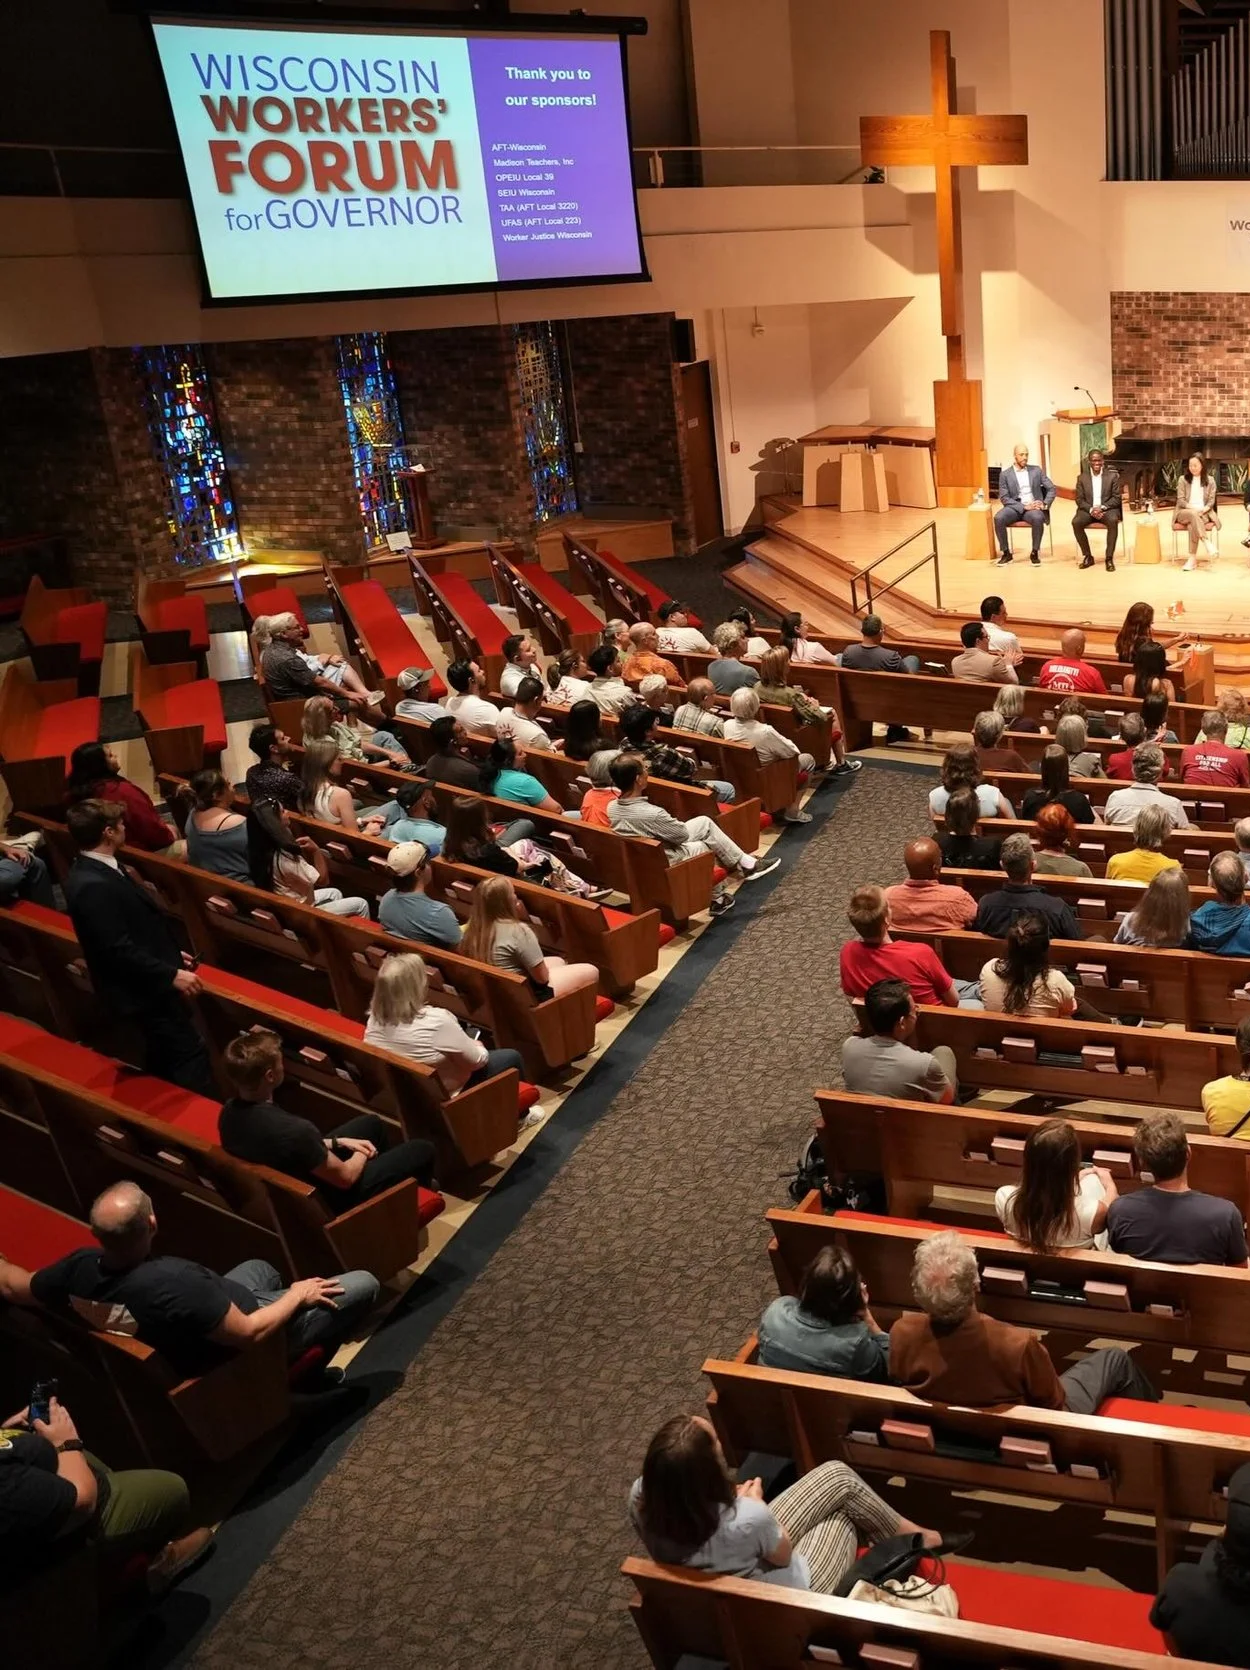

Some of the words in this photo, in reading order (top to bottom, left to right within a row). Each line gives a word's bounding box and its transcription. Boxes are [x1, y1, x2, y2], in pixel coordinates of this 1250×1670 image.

[191, 53, 439, 93] WISCONSIN
[505, 67, 547, 80] Thank
[550, 70, 575, 82] you
[578, 69, 591, 79] to
[505, 95, 528, 105] our
[532, 94, 596, 108] sponsors!
[200, 95, 448, 133] WORKERS'
[208, 140, 459, 194] FORUM
[519, 188, 555, 196] Wisconsin
[499, 204, 515, 212] TAA
[517, 204, 534, 212] (AFT
[537, 203, 556, 211] Local
[558, 202, 578, 211] 3220)
[501, 219, 522, 227] UFAS
[525, 219, 542, 227] (AFT
[565, 216, 582, 225] 223)
[503, 234, 528, 242] Worker
[557, 231, 592, 239] Wisconsin
